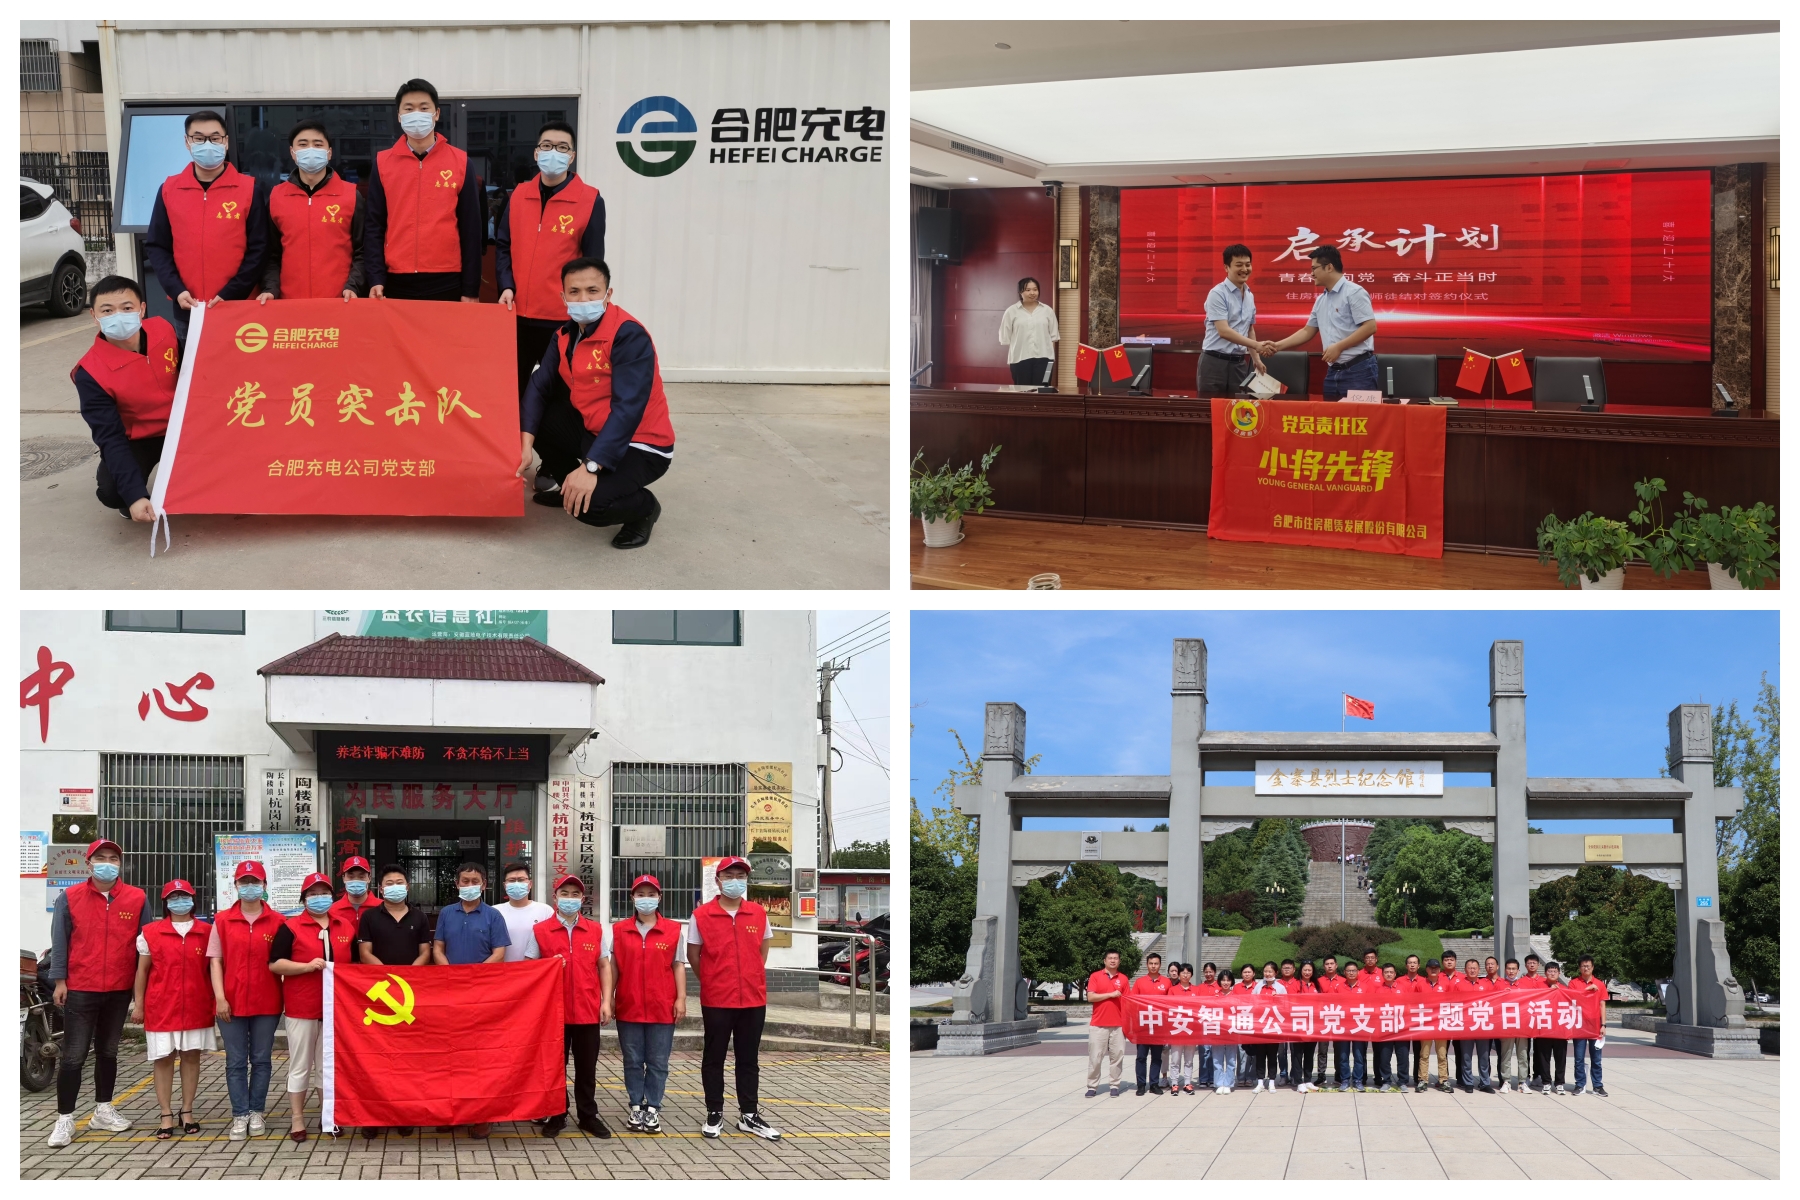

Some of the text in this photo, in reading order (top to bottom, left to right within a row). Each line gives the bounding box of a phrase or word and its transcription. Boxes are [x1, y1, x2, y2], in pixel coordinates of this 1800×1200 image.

[711, 106, 886, 142] 合肥充电
[710, 146, 883, 163] HEFEI CHARGE
[1271, 223, 1499, 264] 启承计划
[1392, 272, 1497, 283] 奋斗正当时
[273, 327, 340, 342] 合肥充电
[301, 341, 339, 349] CHARGE
[226, 381, 482, 427] 党员突击队
[1282, 415, 1368, 436] 党员责任区
[267, 459, 436, 477] 合肥充电公司党支部
[1259, 447, 1394, 492] 小将先锋
[1257, 477, 1373, 493] YOUNG GENERAL VANGUARD
[1273, 514, 1427, 540] 合肥市住房租赁发展股份有限公司
[336, 745, 529, 761] 养老诈骗不难防 不贪不给不上当
[1267, 768, 1414, 788] 金寨县烈士纪念馆
[294, 777, 312, 831] 陶楼镇杭
[344, 782, 518, 811] 为民服务大厅
[562, 780, 570, 810] 中国共产党
[1138, 1000, 1583, 1036] 中安智通公司党支部主题党日活动
